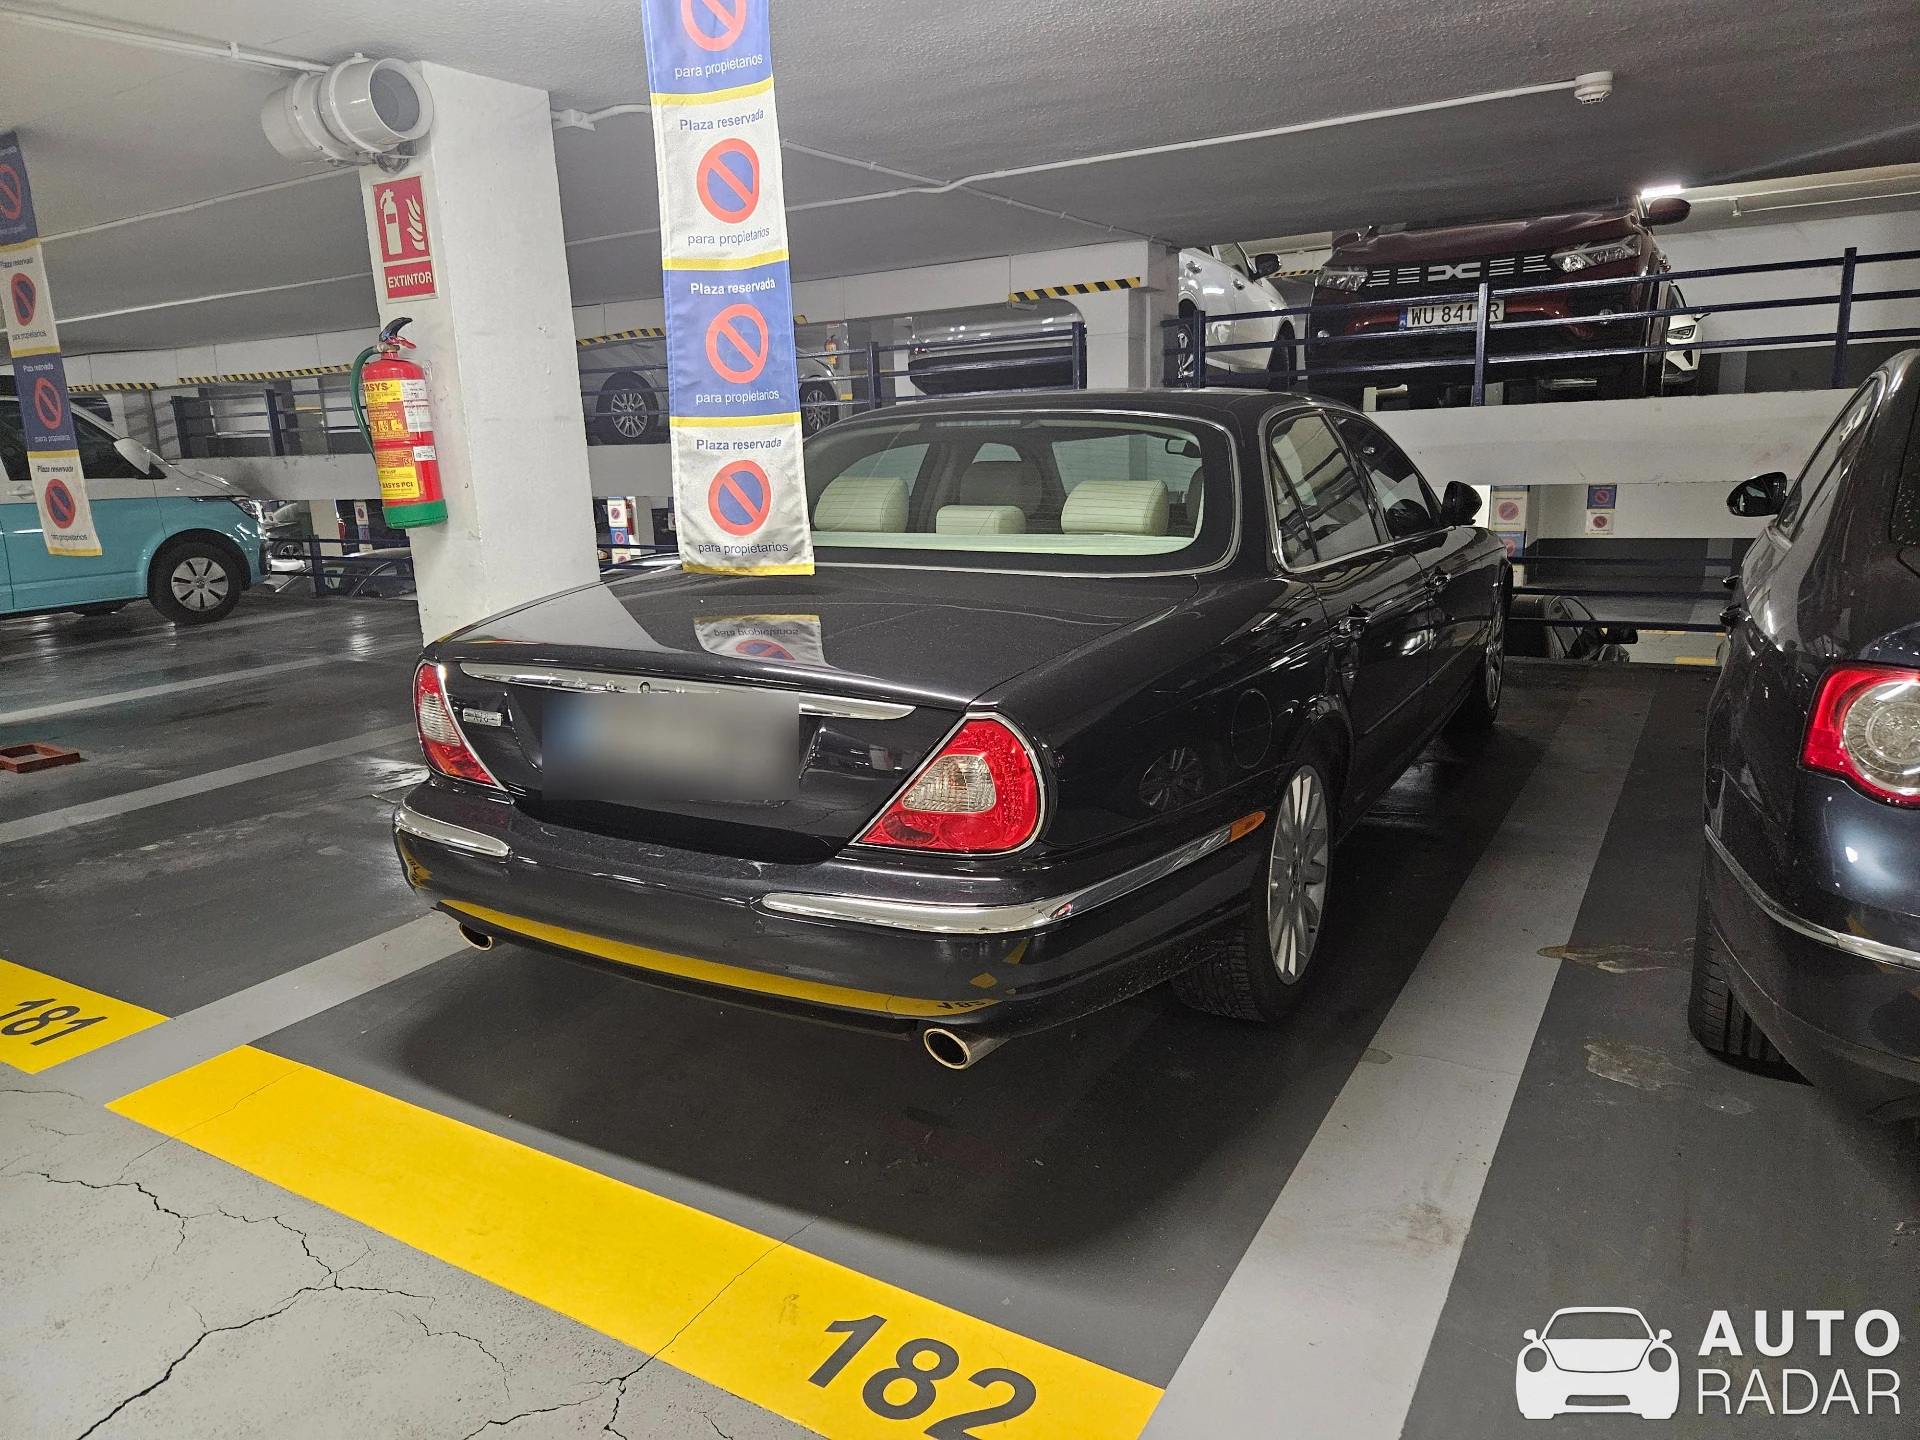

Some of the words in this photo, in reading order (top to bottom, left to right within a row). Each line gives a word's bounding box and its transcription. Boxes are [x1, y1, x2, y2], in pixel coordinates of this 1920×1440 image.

[674, 66, 702, 79] para
[705, 53, 763, 77] propietarios
[679, 119, 713, 131] Plaza
[717, 108, 764, 129] reservada
[688, 234, 715, 246] para
[719, 226, 770, 246] propietarios
[387, 271, 433, 288] EXTINTOR
[690, 282, 725, 295] Plaza
[727, 277, 775, 294] reservada
[1411, 307, 1435, 325] WU
[696, 393, 722, 405] para
[725, 389, 779, 405] propietarios
[696, 439, 729, 450] Plaza
[733, 437, 782, 450] reservada
[698, 544, 721, 553] para
[724, 541, 789, 556] propietarios
[0, 998, 108, 1046] 181
[807, 1314, 1037, 1440] 182
